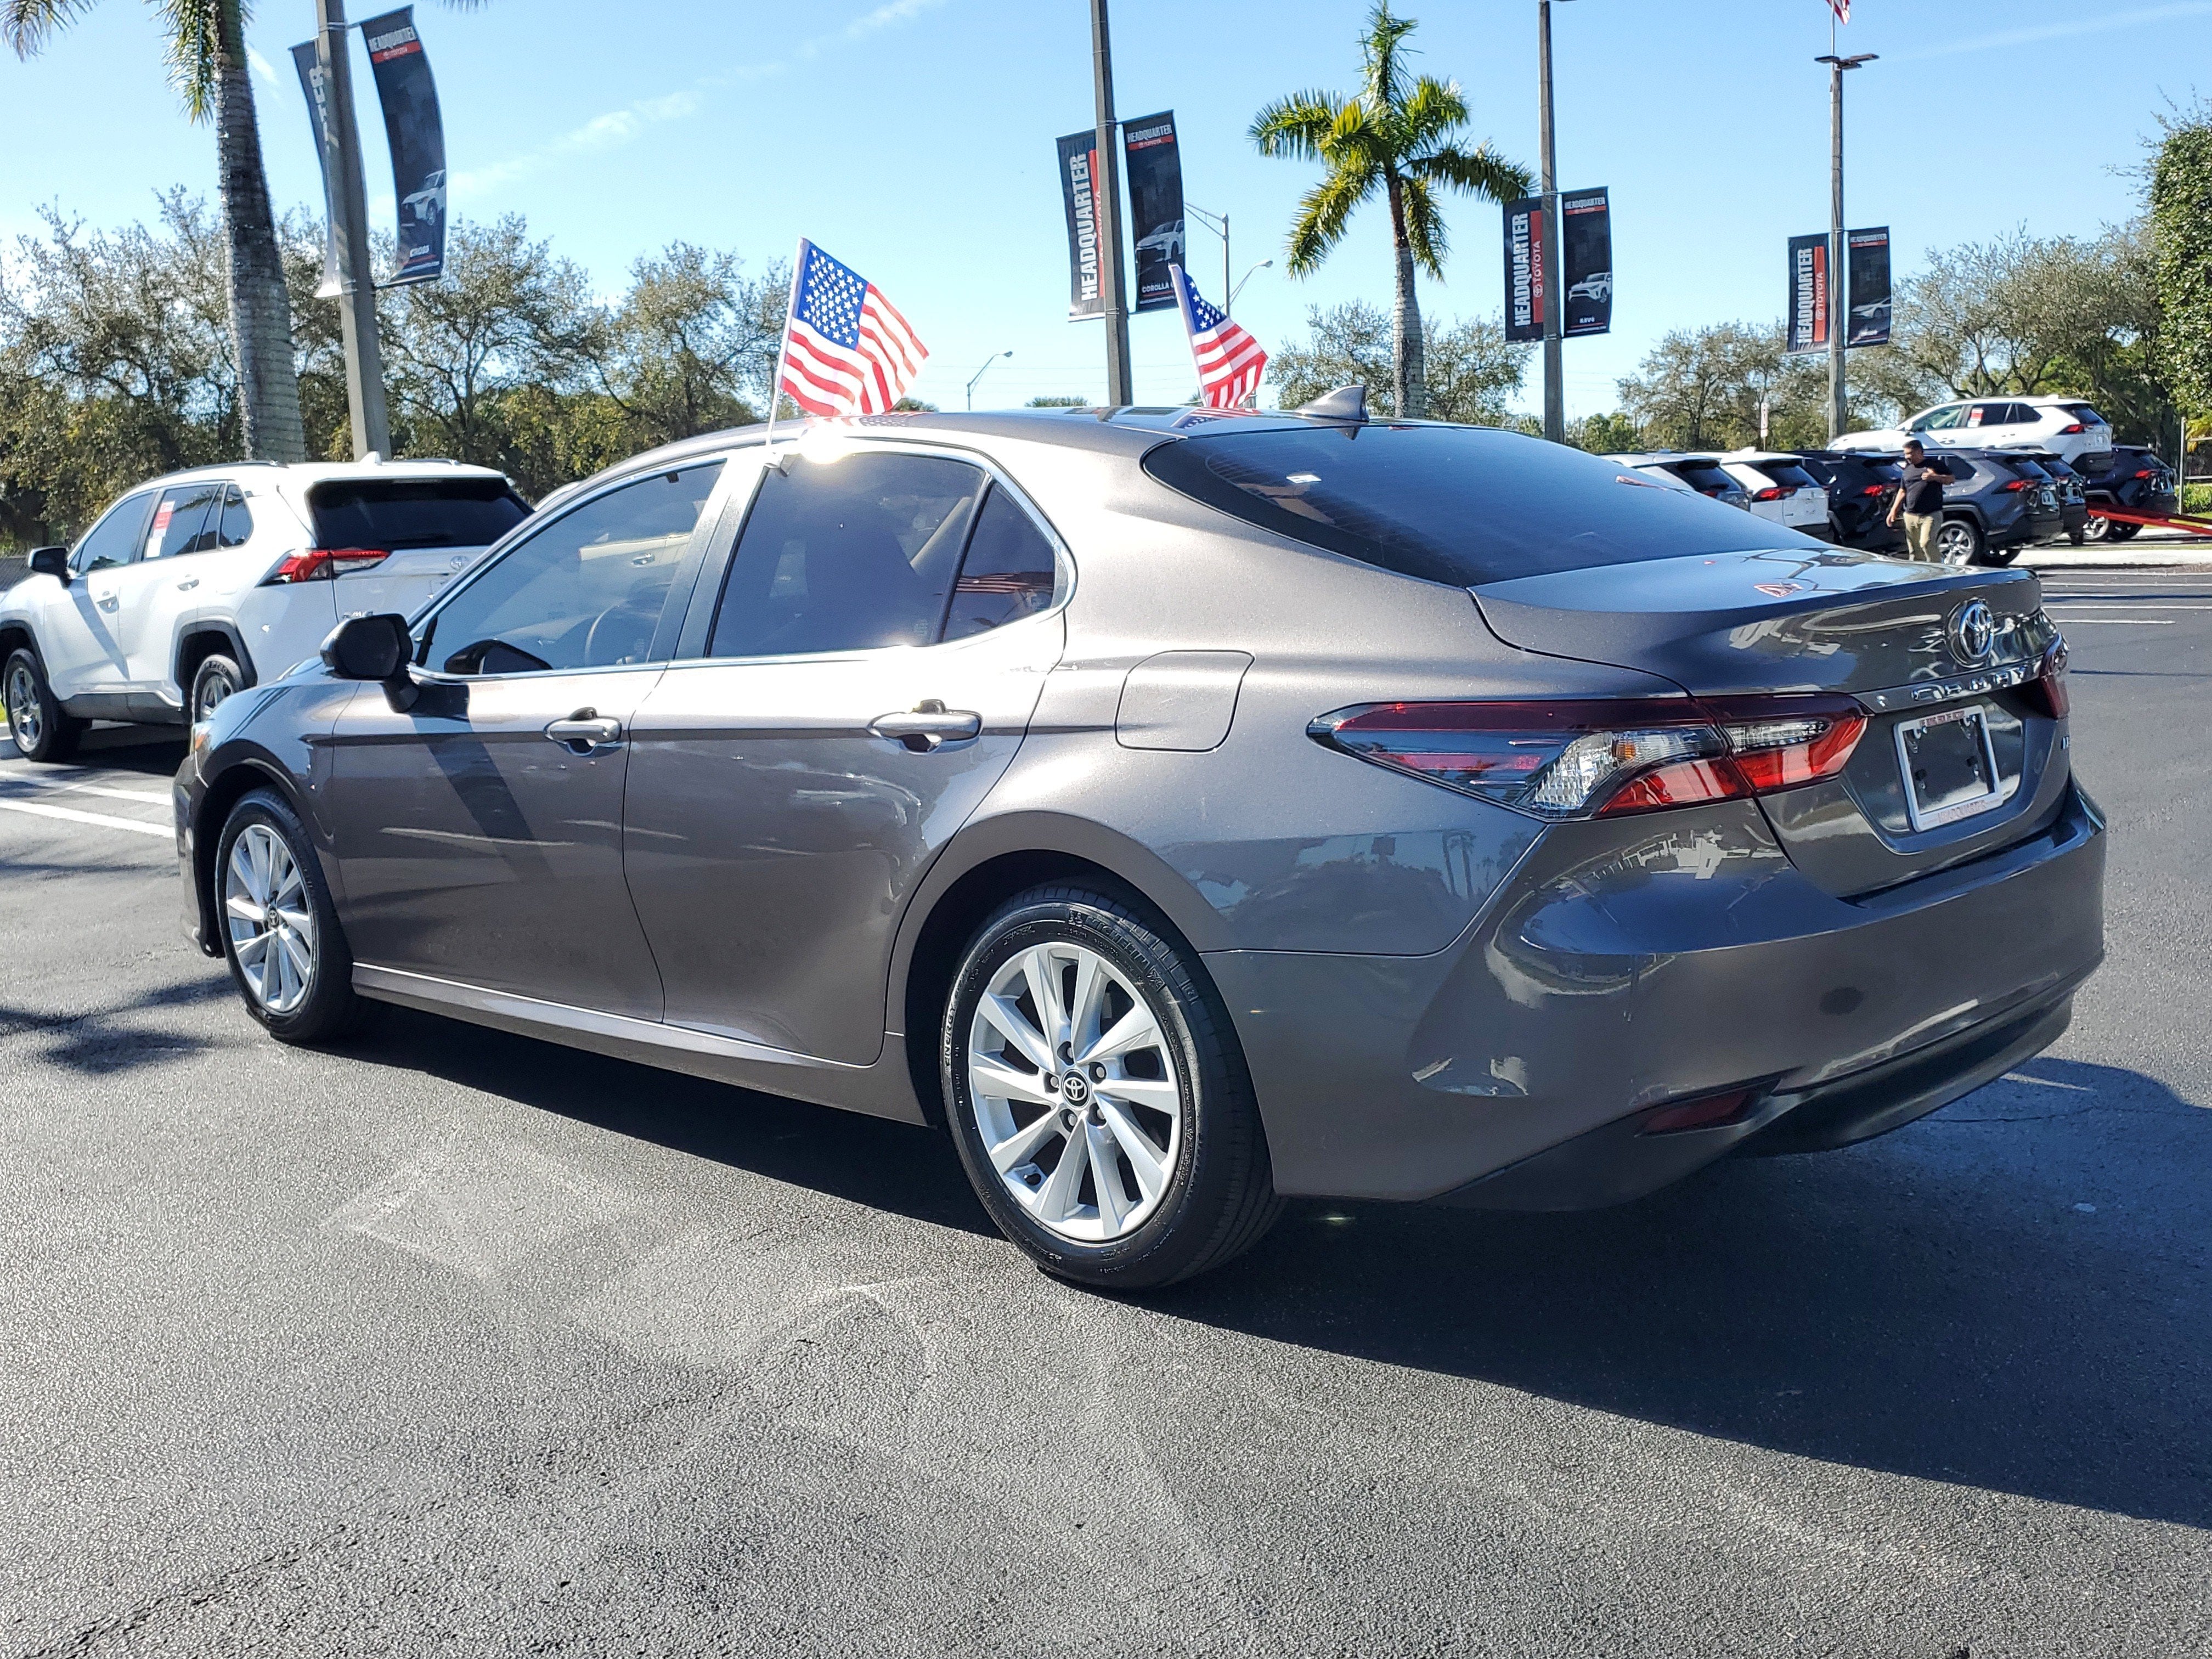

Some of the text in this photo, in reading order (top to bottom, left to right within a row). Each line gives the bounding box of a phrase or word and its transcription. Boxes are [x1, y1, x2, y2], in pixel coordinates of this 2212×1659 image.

[1127, 124, 1173, 143] HEADQUARTER
[1069, 154, 1097, 301] HEADQUARTER
[1142, 281, 1170, 294] COROLLA
[1512, 212, 1532, 326] HEADQUARTER
[1532, 240, 1542, 283] TOYOTA
[1796, 248, 1815, 343] HEADQUARTER
[945, 1003, 956, 1068] ENERGY
